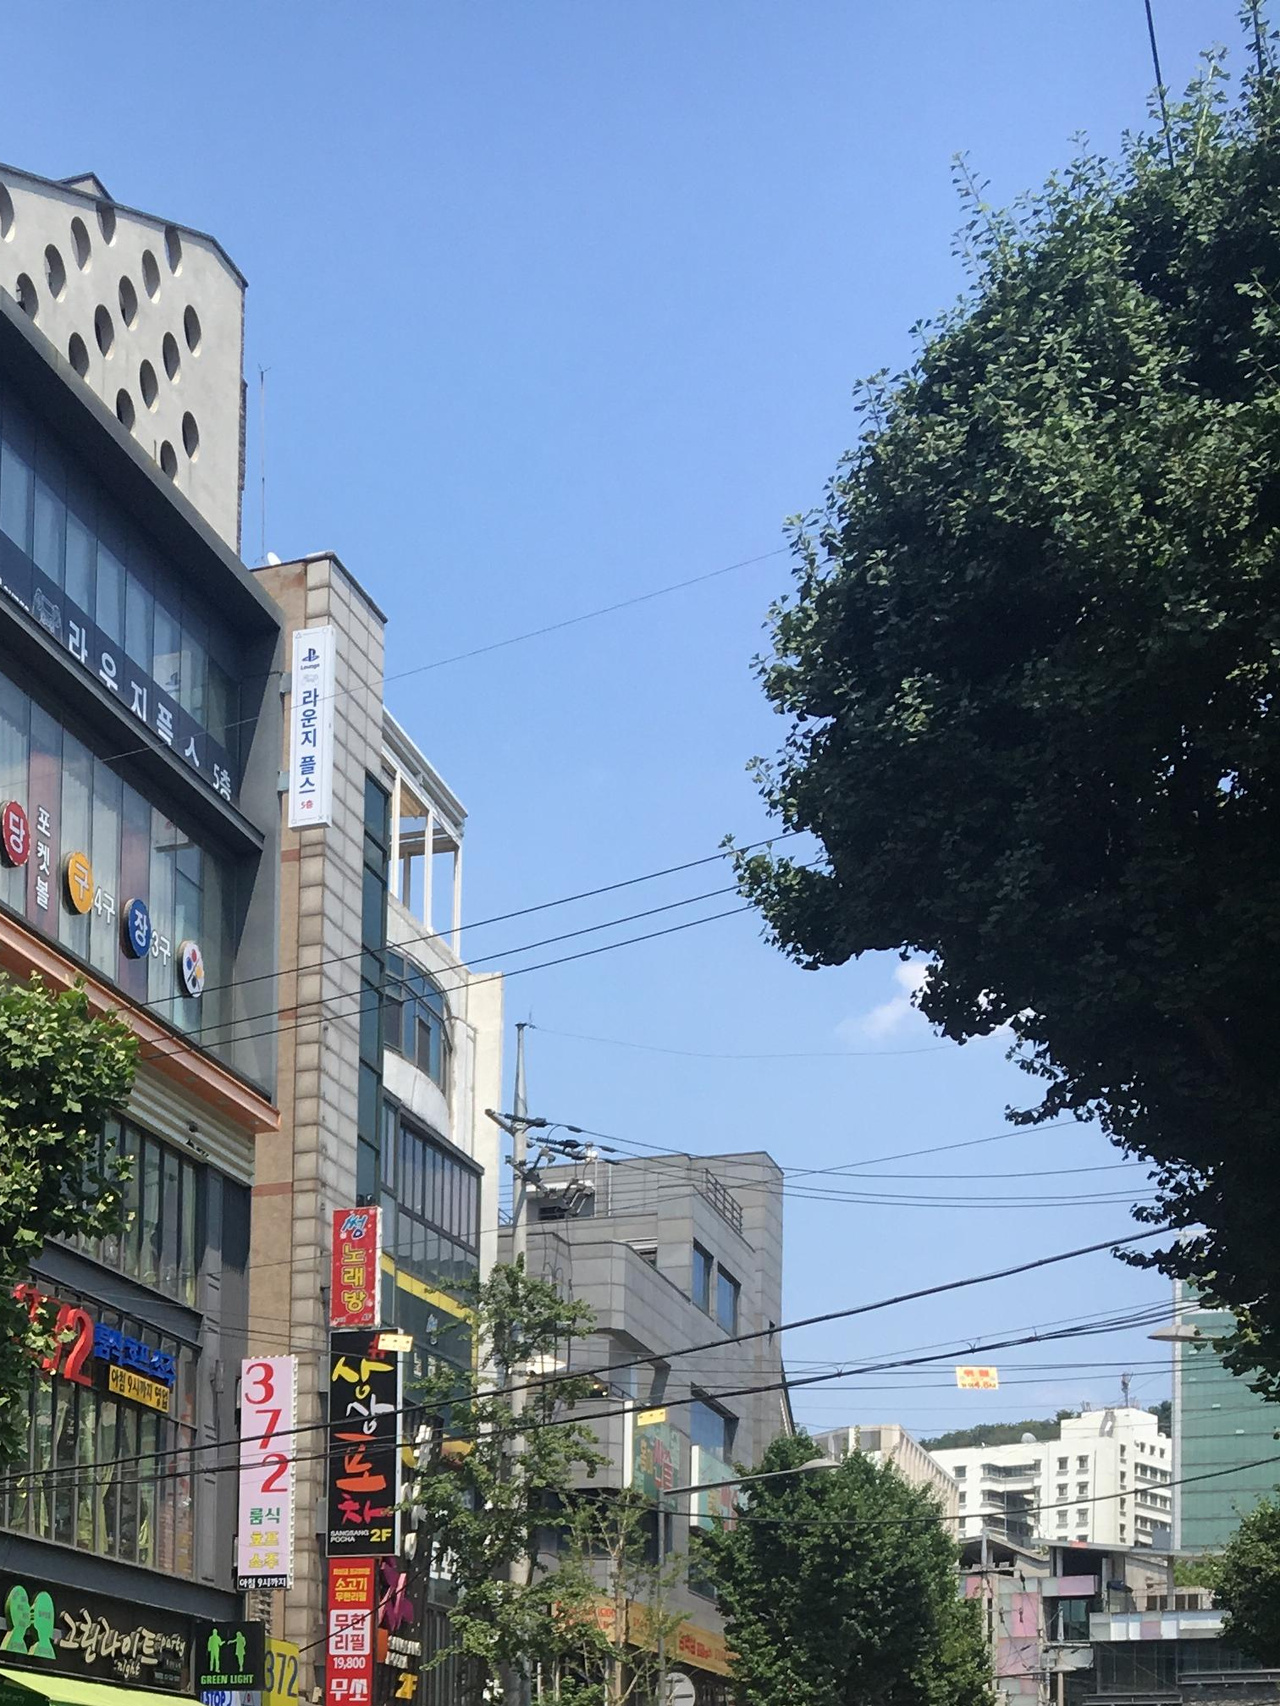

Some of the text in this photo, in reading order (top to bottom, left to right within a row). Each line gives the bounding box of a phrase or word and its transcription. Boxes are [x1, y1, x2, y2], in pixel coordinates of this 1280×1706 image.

[36, 805, 51, 911] 포켓볼
[93, 886, 116, 924] 4구
[151, 929, 171, 966] 3구
[340, 1243, 369, 1314] 노래방
[12, 1283, 94, 1387] 72
[111, 1369, 127, 1394] 아침
[128, 1376, 153, 1401] 9시까지
[245, 1362, 288, 1494] 372
[332, 1355, 395, 1526] 상상포차
[250, 1507, 281, 1525] 룸식
[249, 1530, 280, 1547] 호프
[330, 1528, 393, 1543] SANGSANG 2F
[249, 1552, 280, 1569] 소주
[239, 1576, 288, 1589] 아침 9시까지
[335, 1578, 368, 1591] 소고기
[335, 1592, 367, 1602] 무한리필
[334, 1613, 366, 1631] 무한
[60, 1606, 159, 1665] 그린라이트
[334, 1634, 365, 1651] 리필
[333, 1657, 366, 1669] 19,800
[201, 1674, 254, 1685] GREEN LIGHT
[264, 1649, 298, 1698] 372
